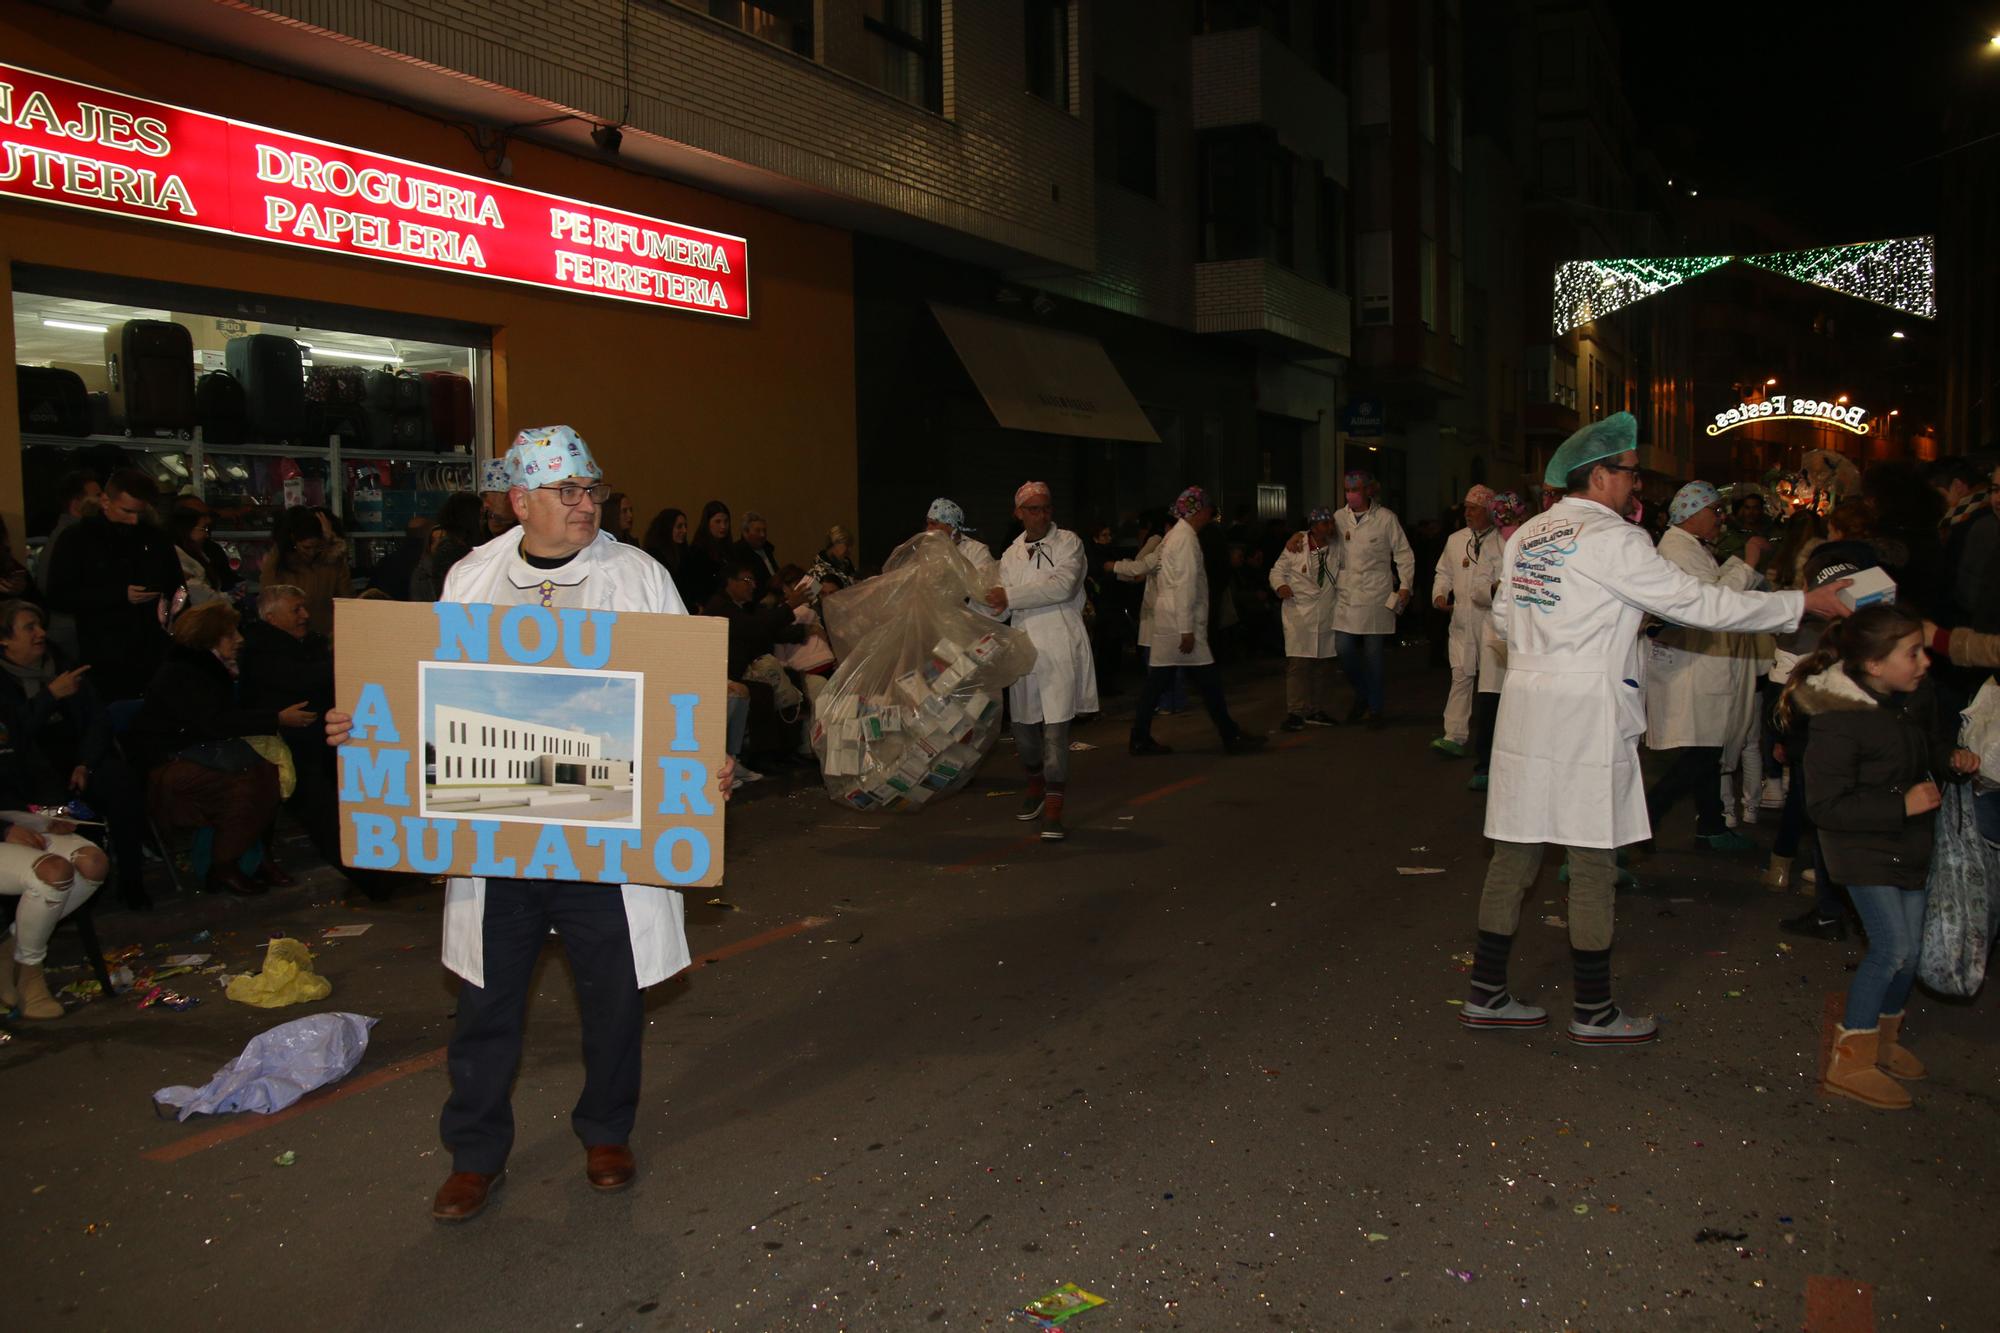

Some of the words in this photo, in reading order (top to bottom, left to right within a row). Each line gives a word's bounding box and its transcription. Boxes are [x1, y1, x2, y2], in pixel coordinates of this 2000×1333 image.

[255, 144, 504, 228] DROGUERIA
[265, 196, 486, 268] PAPELERIA
[550, 208, 730, 274] PERFUMERIA
[555, 249, 728, 309] FERRETERIA
[433, 602, 616, 669] NOU
